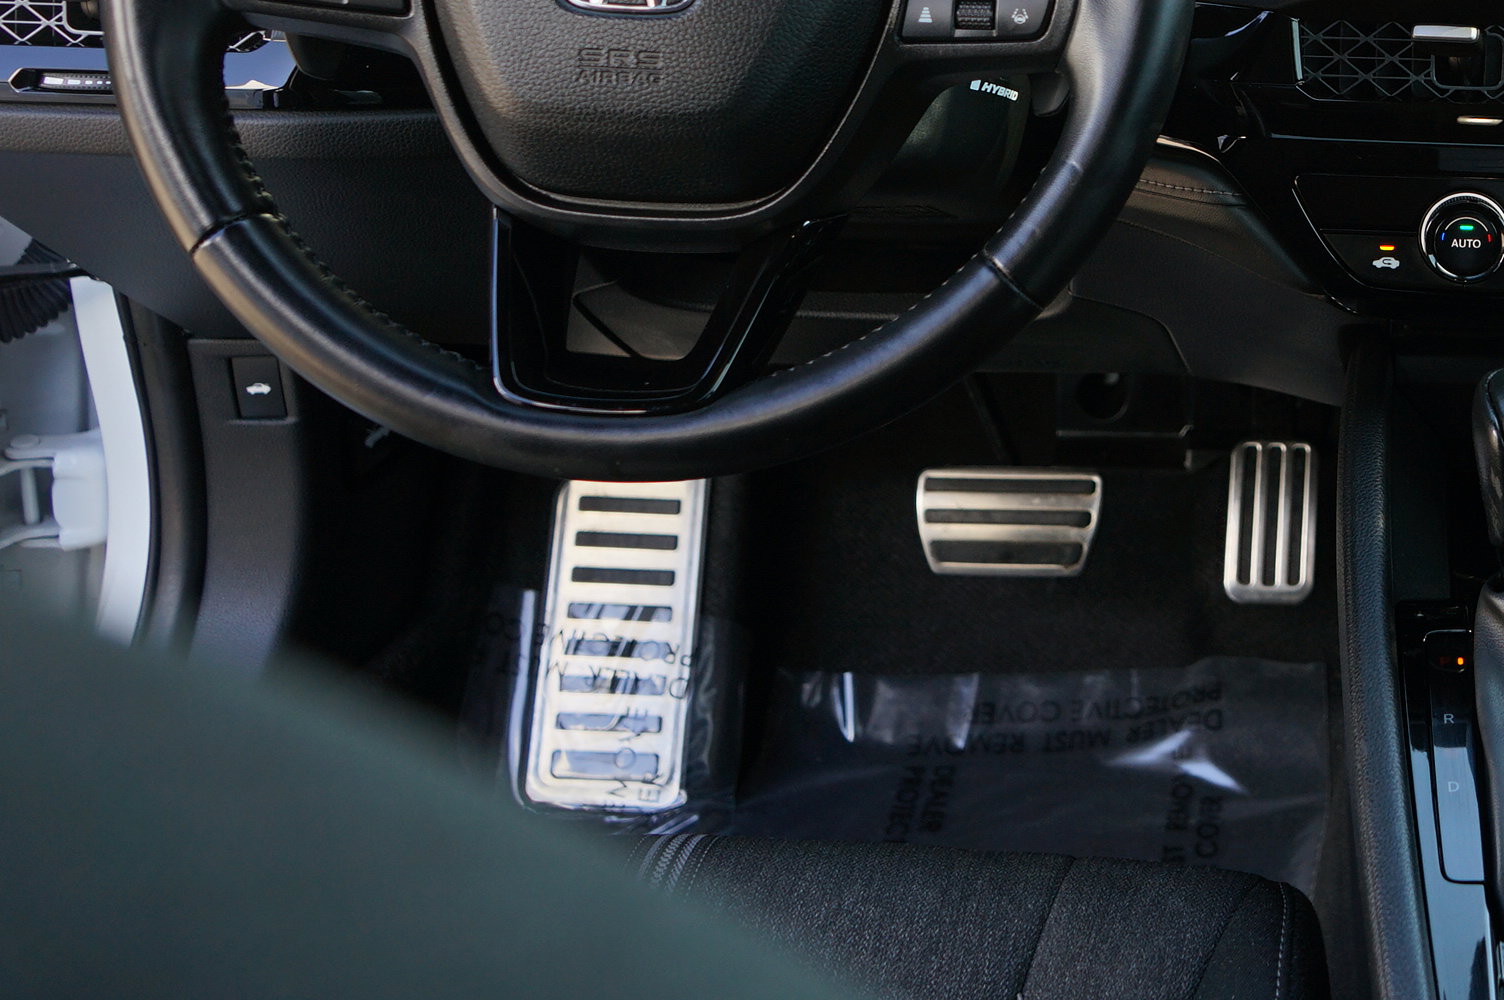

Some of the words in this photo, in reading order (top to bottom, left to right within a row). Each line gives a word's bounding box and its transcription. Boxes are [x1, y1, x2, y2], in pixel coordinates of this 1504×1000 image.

[981, 81, 1019, 102] HYBRID
[1451, 239, 1482, 249] AUTO
[1443, 713, 1455, 725] R
[1447, 781, 1460, 792] D
